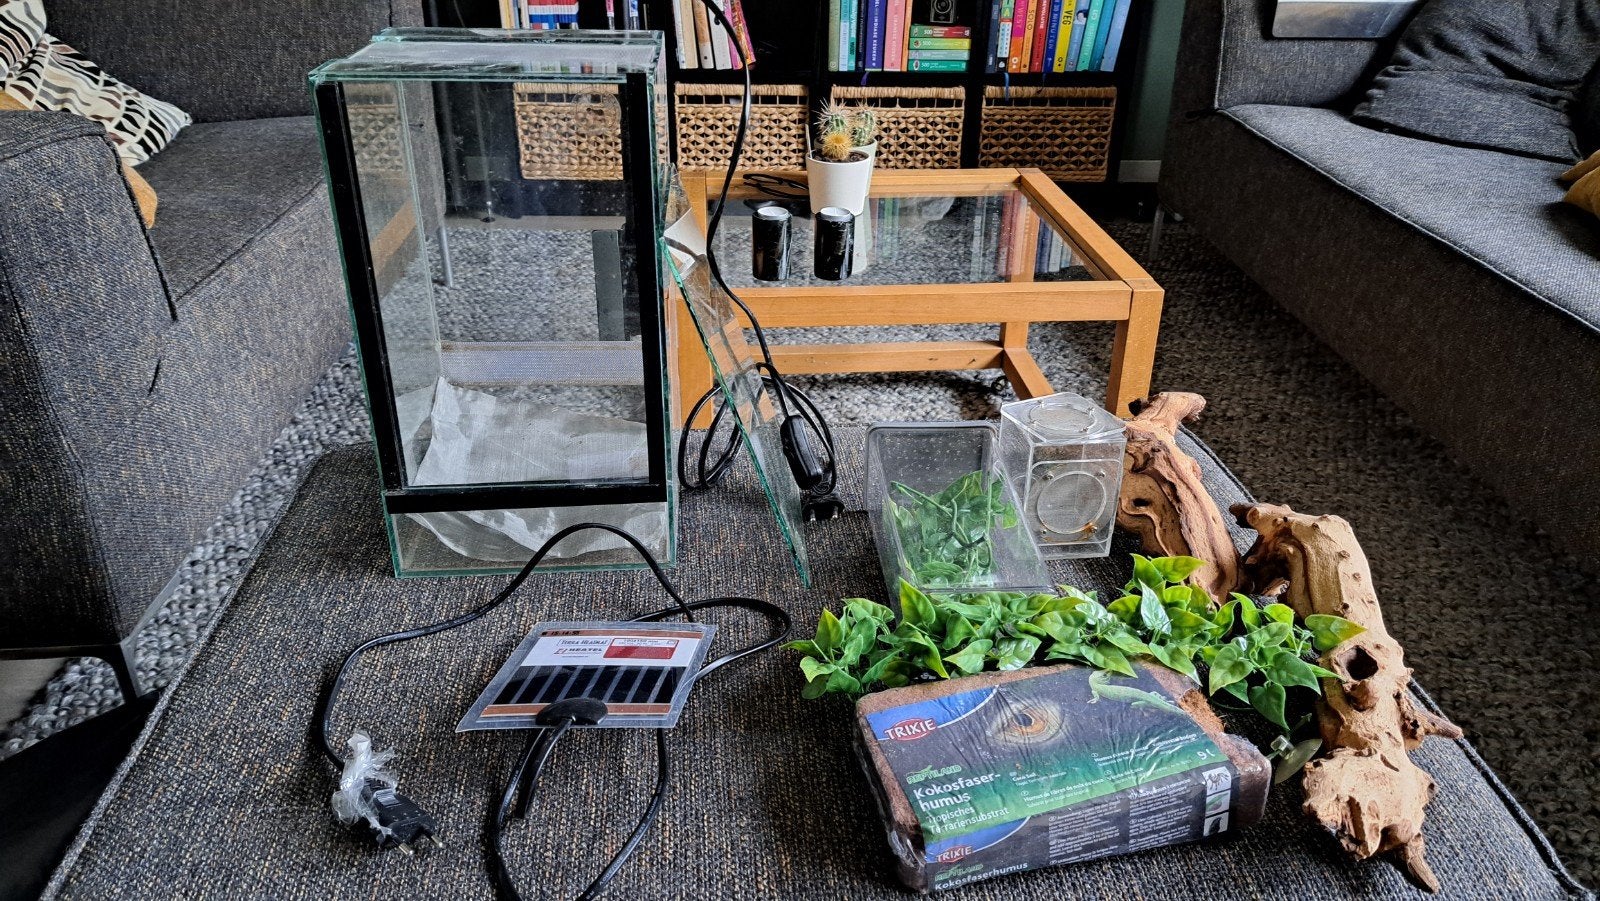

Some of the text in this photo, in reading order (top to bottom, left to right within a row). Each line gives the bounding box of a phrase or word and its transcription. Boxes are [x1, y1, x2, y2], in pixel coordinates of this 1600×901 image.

[1026, 9, 1035, 30] SOLO
[1061, 10, 1074, 26] VEG
[884, 718, 937, 740] TRIXIE
[1196, 751, 1208, 760] 9
[906, 764, 962, 785] REPTILAND
[913, 772, 1001, 800] Kokosfaser-
[918, 792, 971, 812] humus
[926, 806, 975, 824] Tropisches
[929, 807, 1010, 835] Terrariensubstrat
[936, 846, 973, 863] TRIXIE
[935, 862, 1028, 891] Kokosfaserhumus
